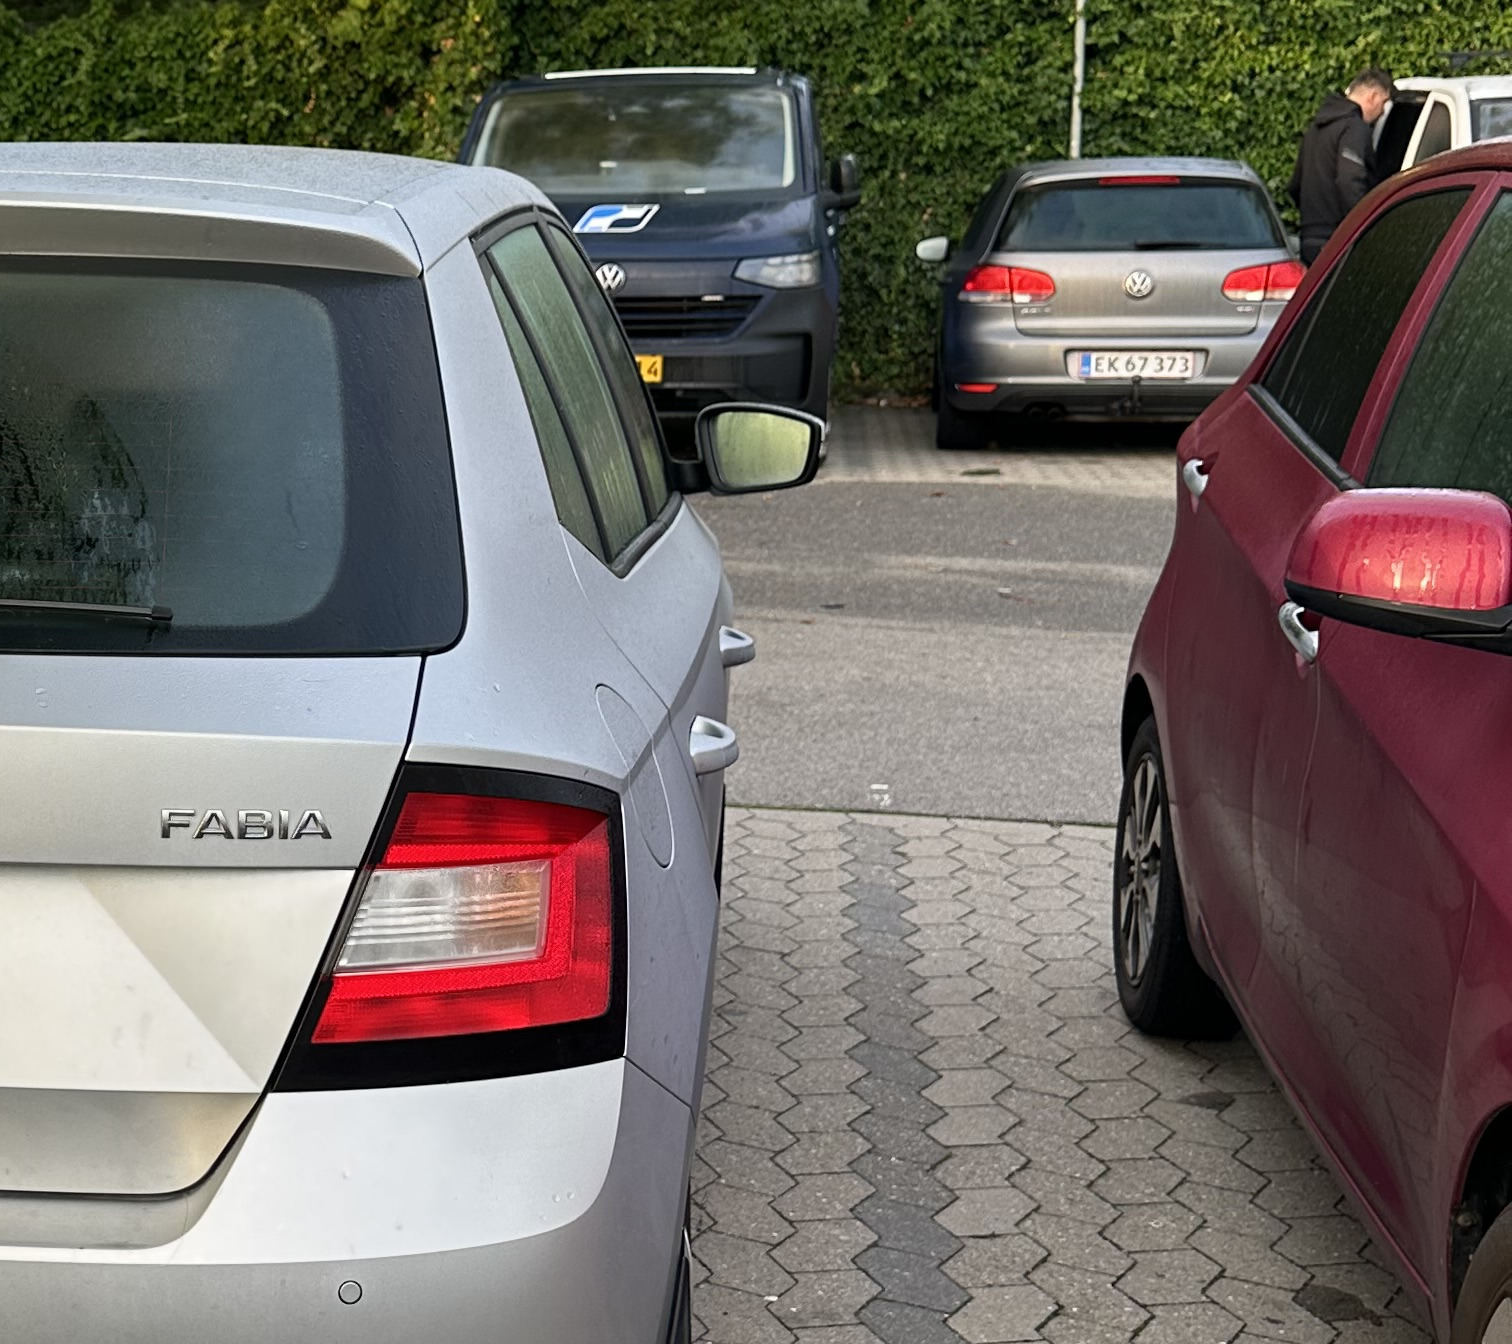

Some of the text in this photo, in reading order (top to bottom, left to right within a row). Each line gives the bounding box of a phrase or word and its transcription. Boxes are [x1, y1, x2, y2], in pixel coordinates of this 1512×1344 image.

[1095, 356, 1119, 373] EK
[1125, 354, 1148, 373] 67
[1153, 356, 1189, 373] 373
[160, 808, 332, 840] FABIA
